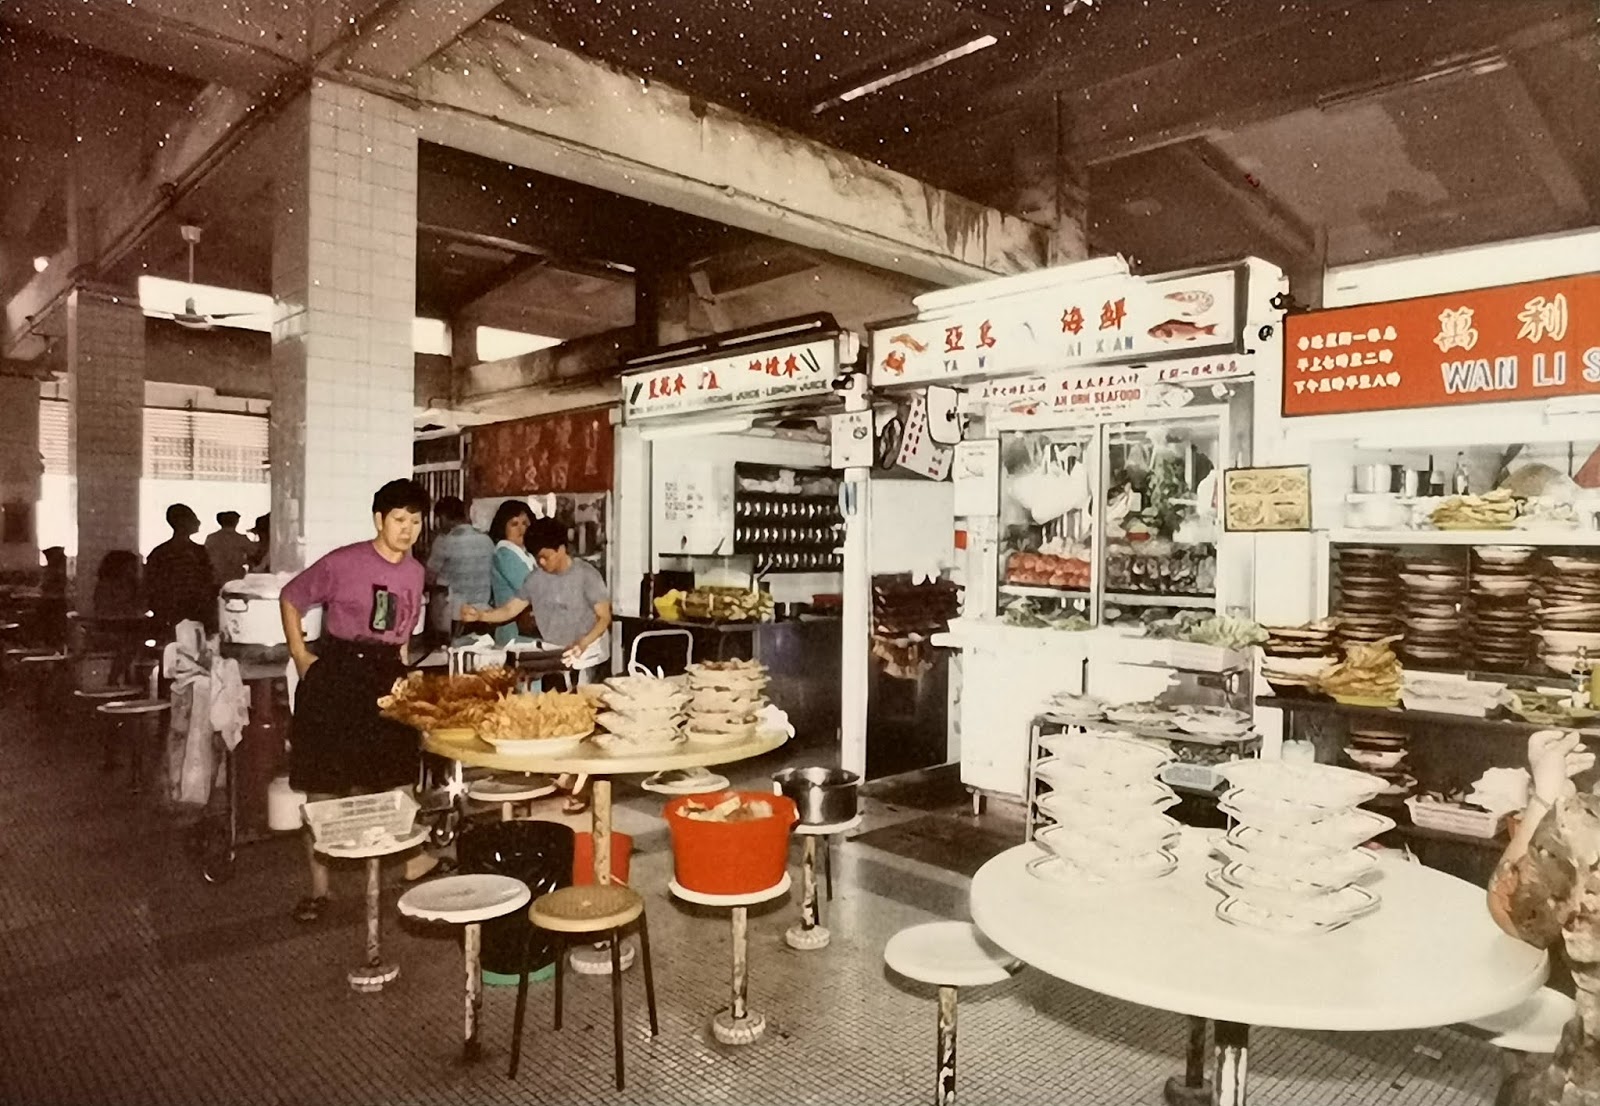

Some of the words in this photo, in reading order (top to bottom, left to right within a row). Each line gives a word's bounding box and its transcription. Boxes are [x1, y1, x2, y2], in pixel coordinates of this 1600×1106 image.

[1440, 355, 1518, 395] WAN
[1532, 350, 1566, 388] LI
[1094, 388, 1141, 404] SEAFOOD
